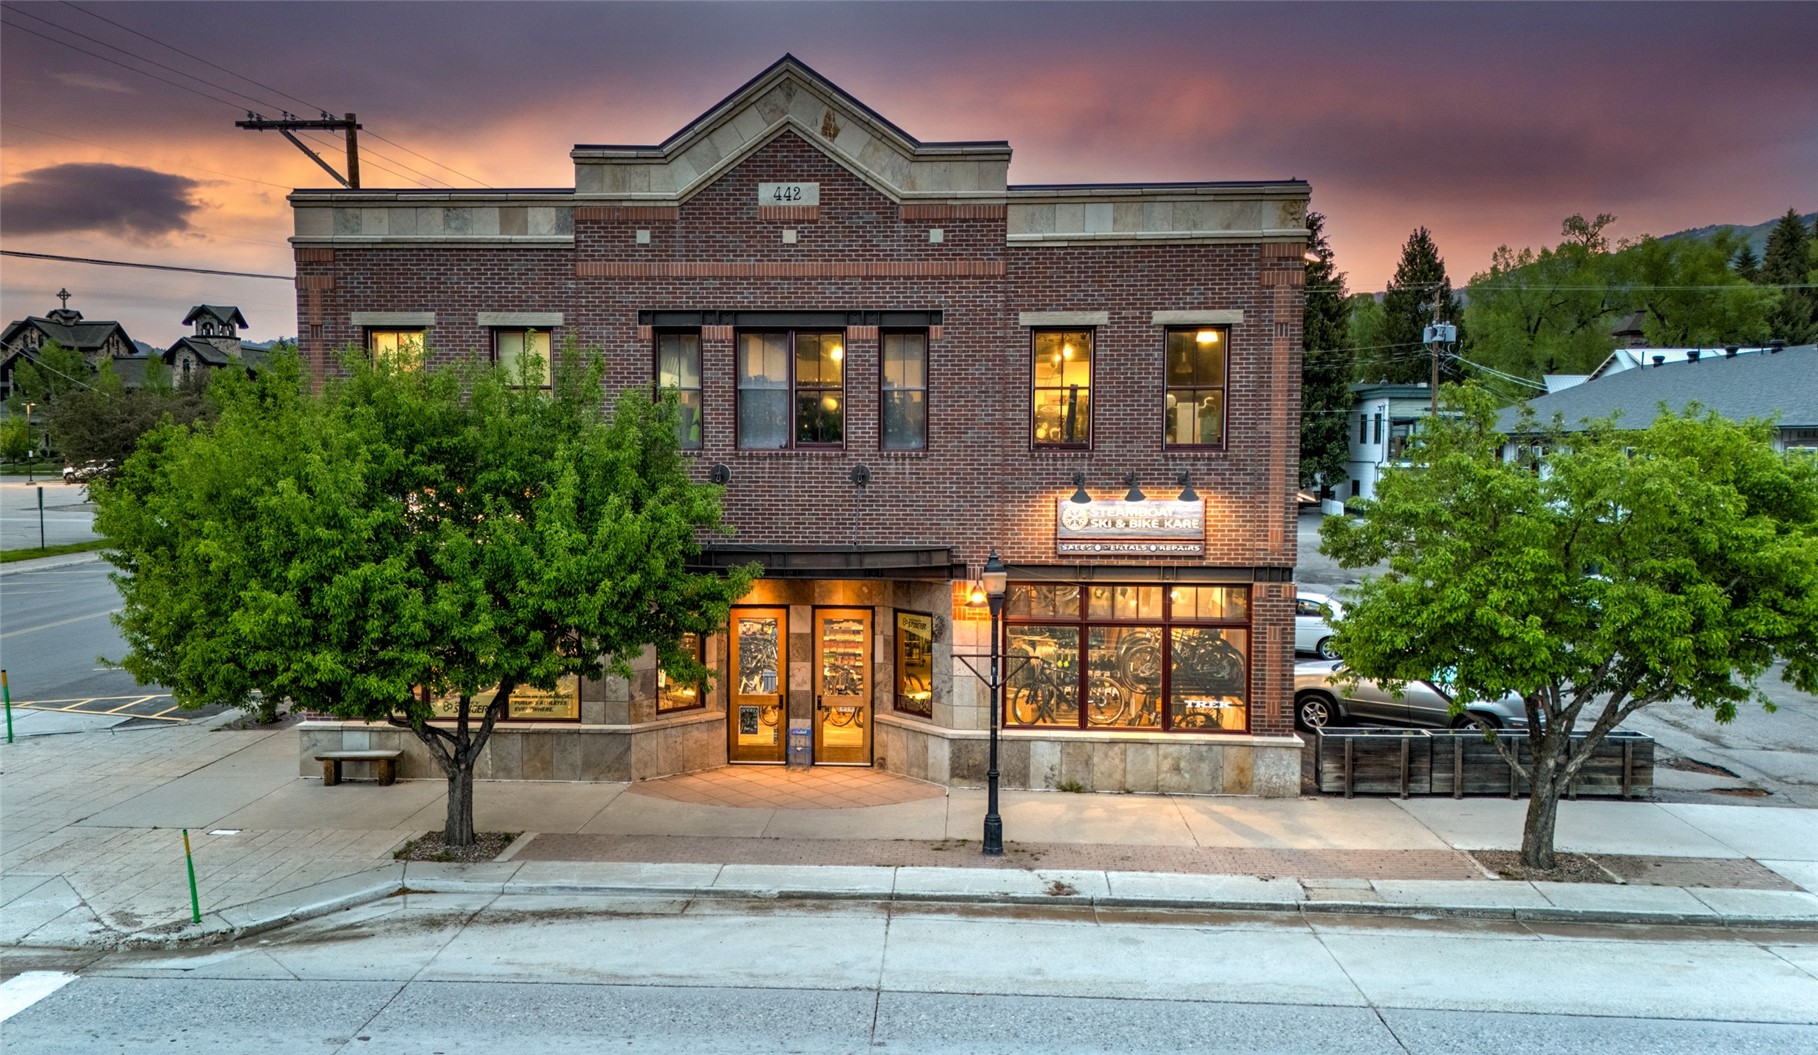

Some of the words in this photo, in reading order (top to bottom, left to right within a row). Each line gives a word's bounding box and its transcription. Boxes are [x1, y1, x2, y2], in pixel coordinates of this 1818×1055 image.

[773, 186, 802, 201] 442
[1089, 507, 1174, 517] STEAMBOAT
[1090, 519, 1112, 529] SKI
[1115, 519, 1126, 529] &
[1129, 519, 1159, 529] BIKE
[1164, 519, 1200, 529] KARE
[453, 704, 489, 714] SGER
[1184, 700, 1232, 708] TREK
